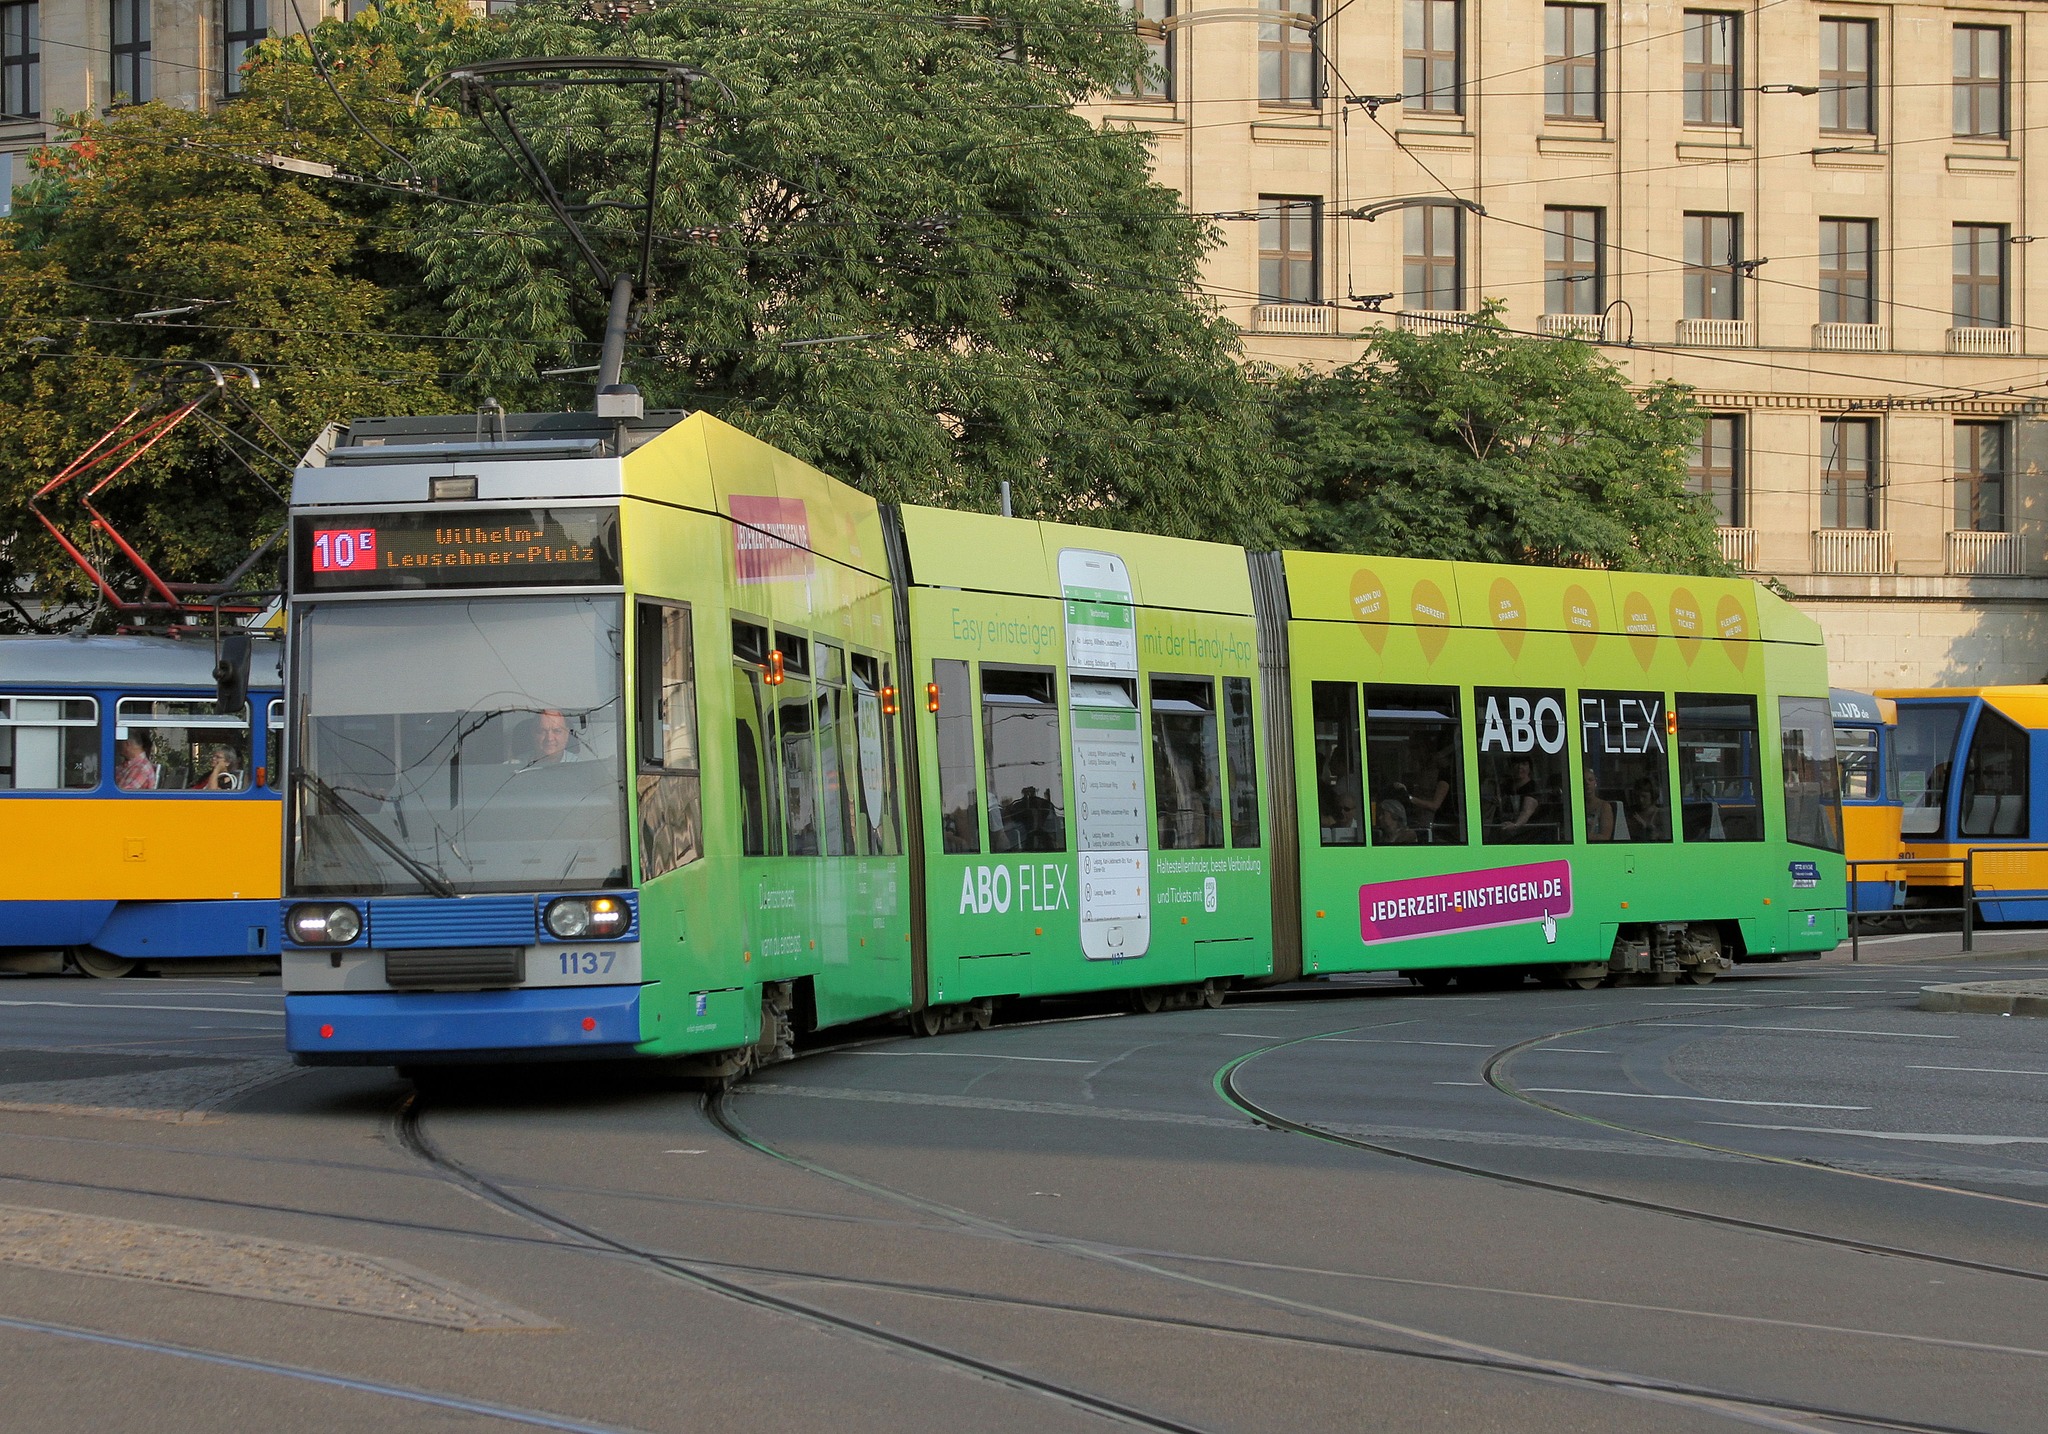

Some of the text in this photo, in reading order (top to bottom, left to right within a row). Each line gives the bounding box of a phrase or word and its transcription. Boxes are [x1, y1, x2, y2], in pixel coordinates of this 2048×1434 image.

[436, 527, 544, 545] Wilhelm-
[387, 545, 594, 567] Leuschner-Platz
[1354, 592, 1372, 605] WANN
[1360, 602, 1380, 615] WILLST
[1415, 603, 1445, 620] JEDERZEIT
[1498, 610, 1519, 621] SPAREN
[1572, 606, 1588, 617] GANZ
[952, 608, 1057, 655] Easy einsteigen
[1571, 617, 1592, 628] LEIPZIG
[1678, 619, 1695, 630] TICKET
[1143, 627, 1251, 669] mit der Handy-App
[1481, 696, 1665, 754] ABO FLEX
[1156, 856, 1261, 875] Haltestellenfinder, beste Verbindung
[959, 864, 1069, 915] ABO FLEX
[1157, 887, 1202, 904] und Tickets mit
[1370, 878, 1561, 922] JEDERZEIT-EINSTEIGEN.DE
[559, 951, 617, 975] 1137
